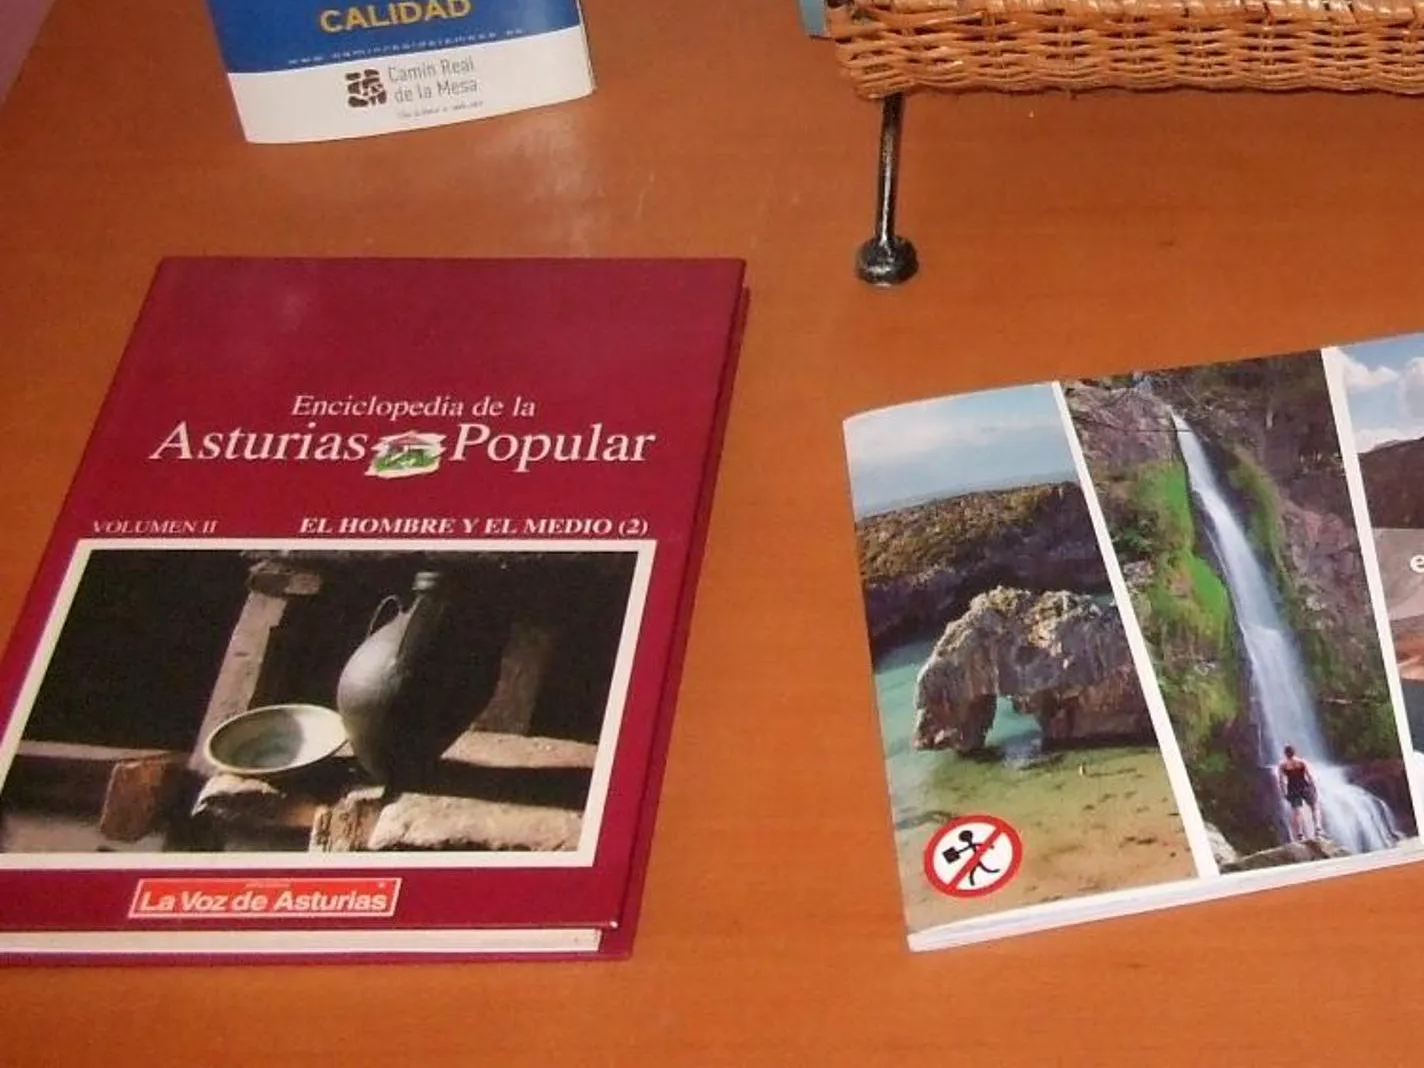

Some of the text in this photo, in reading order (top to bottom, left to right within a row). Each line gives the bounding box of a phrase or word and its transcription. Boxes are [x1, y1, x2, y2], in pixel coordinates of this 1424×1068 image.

[441, 54, 475, 75] Real
[394, 78, 479, 104] de la Mesa
[291, 395, 537, 421] Enciclopedia de la
[148, 420, 657, 474] Asturias Popular
[92, 519, 198, 534] VOLUMEN
[299, 518, 649, 537] EL HOMBRE Y EL MEDIO (2)
[139, 890, 388, 912] La Voz de Asturias
